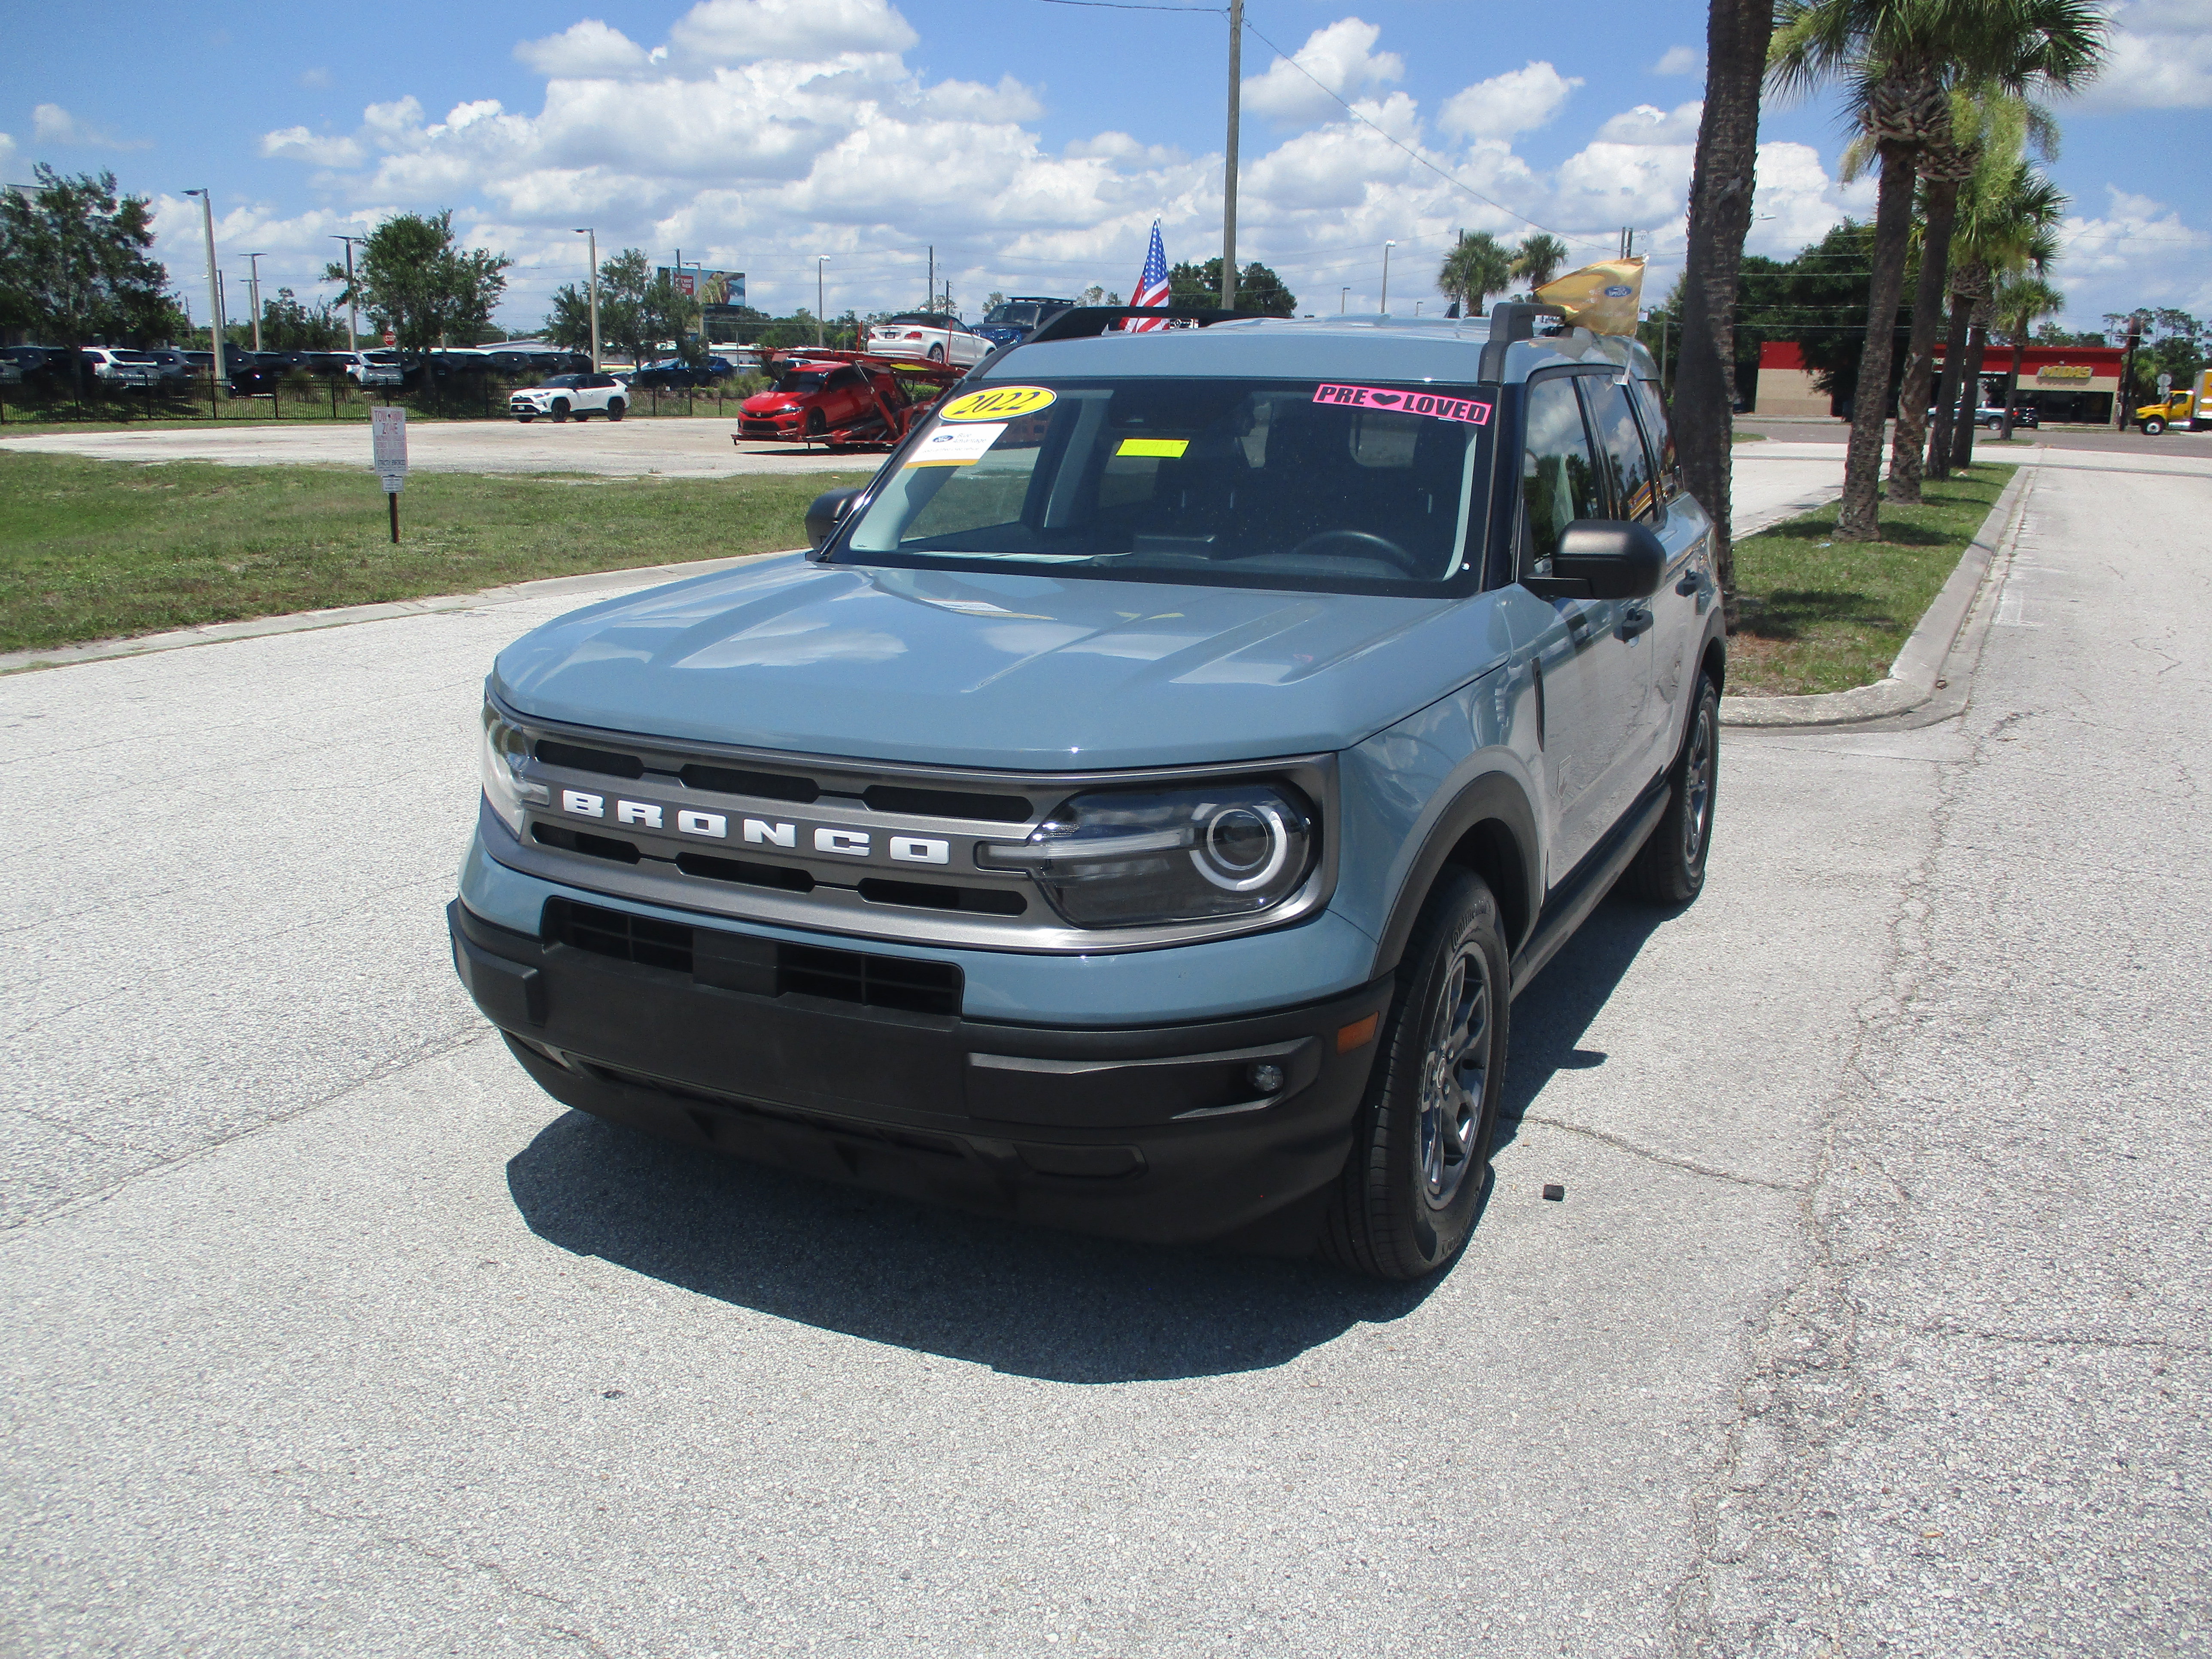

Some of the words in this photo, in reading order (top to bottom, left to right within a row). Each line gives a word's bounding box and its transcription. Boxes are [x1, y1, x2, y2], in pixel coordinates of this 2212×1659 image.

[2037, 366, 2094, 378] MIDAS
[951, 392, 1041, 415] 2022
[1317, 386, 1369, 404] PRE
[1402, 395, 1486, 422] LOVED
[382, 423, 398, 434] ZONE
[562, 789, 950, 865] BRONCO
[1451, 905, 1487, 953] Continental
